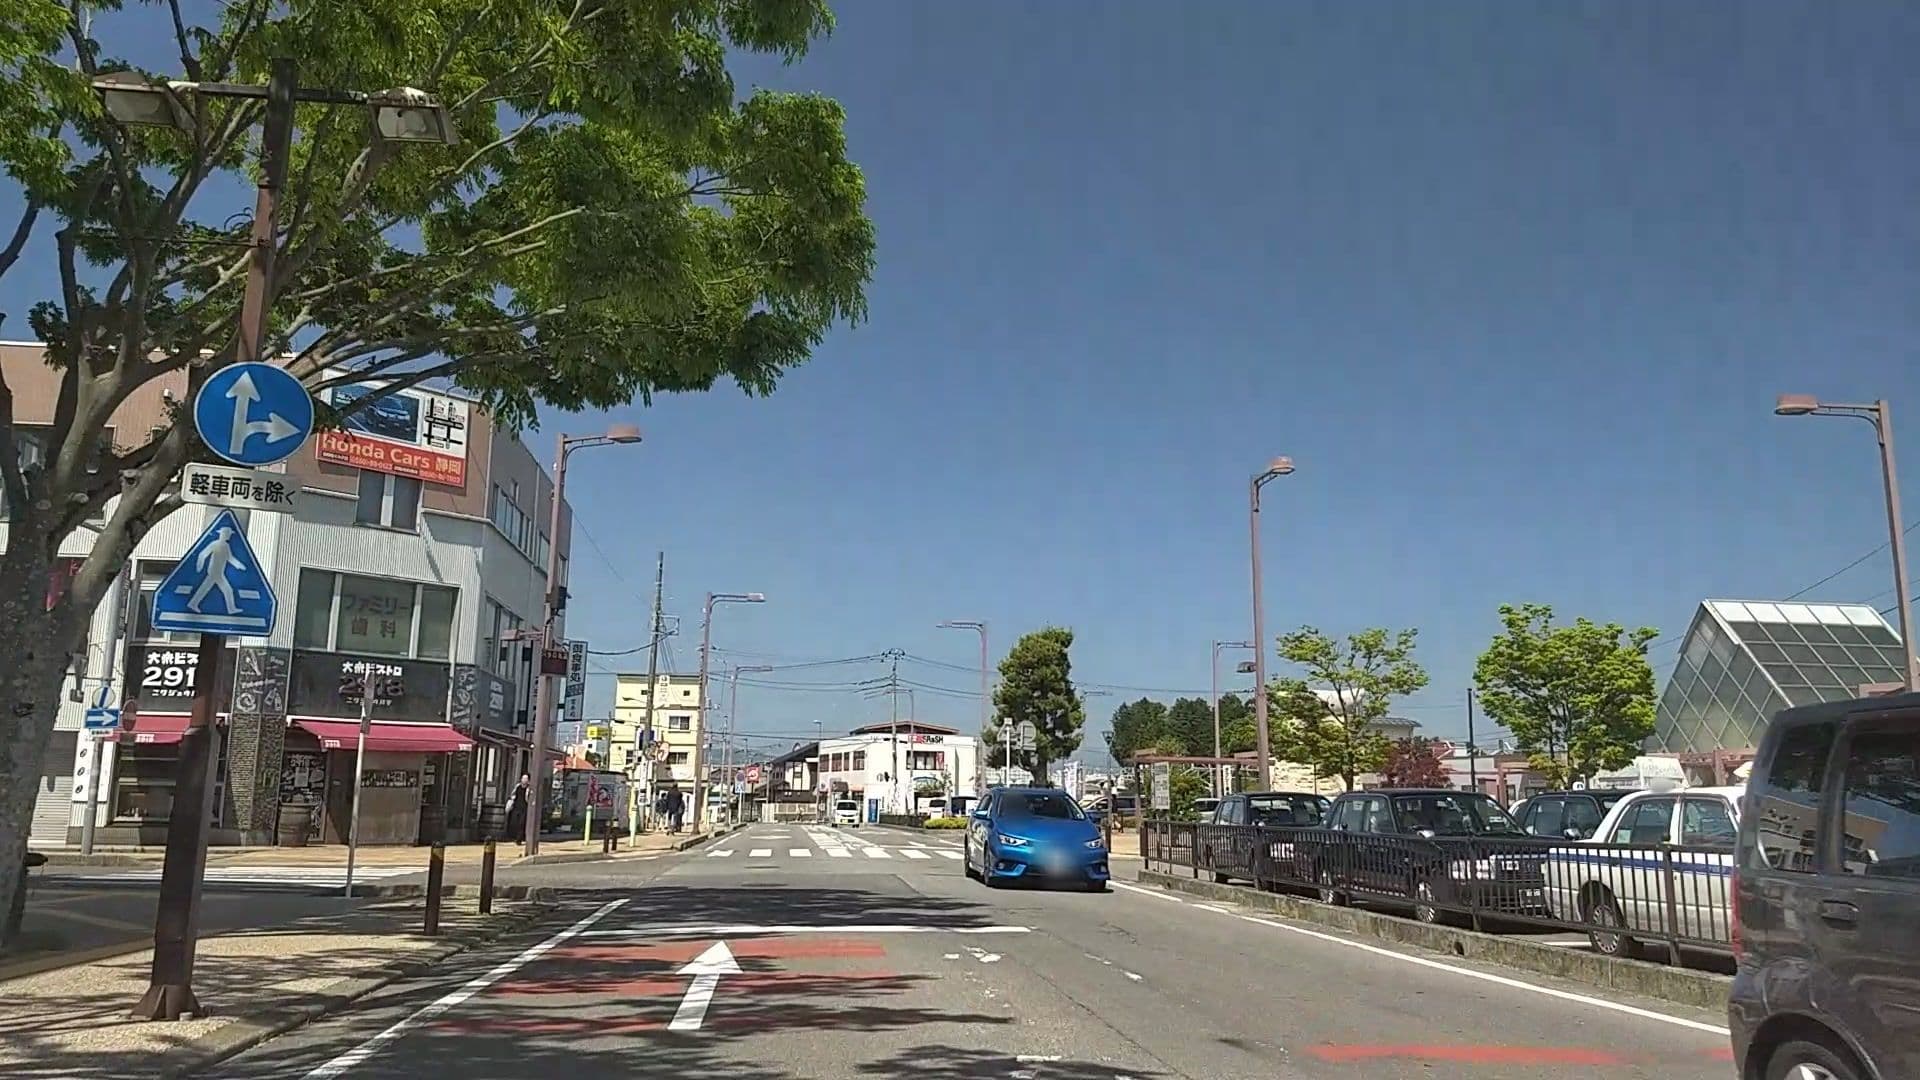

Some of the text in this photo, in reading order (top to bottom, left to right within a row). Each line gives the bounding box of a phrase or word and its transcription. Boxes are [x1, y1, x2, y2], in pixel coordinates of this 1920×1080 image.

[322, 432, 385, 460] Honda
[390, 447, 431, 469] Cars
[435, 456, 462, 476] 静岡
[189, 472, 296, 505] 軽車両を除く
[344, 594, 410, 616] ファミリー
